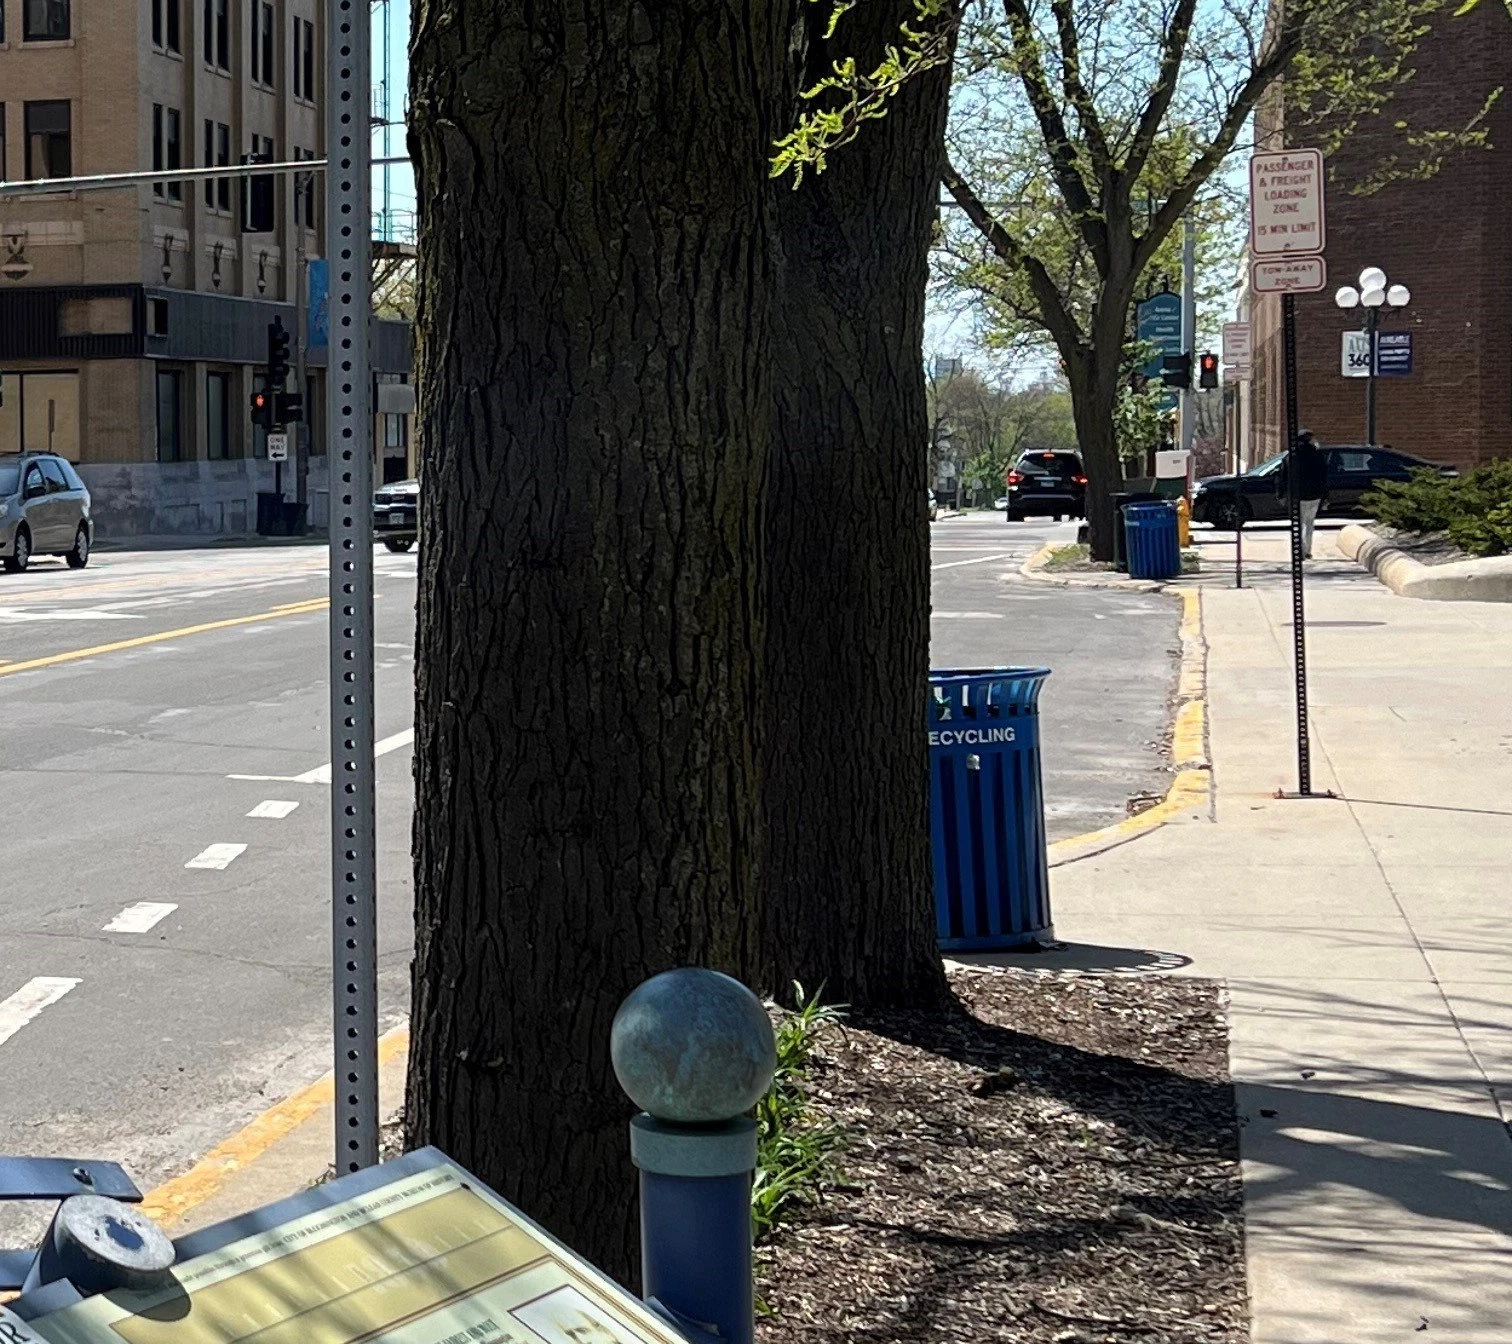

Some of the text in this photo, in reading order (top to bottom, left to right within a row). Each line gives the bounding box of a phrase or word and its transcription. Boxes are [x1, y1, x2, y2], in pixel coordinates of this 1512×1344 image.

[1256, 159, 1314, 174] PASSENGER
[1271, 174, 1312, 186] FREIGHT
[1265, 189, 1308, 201] LOADING
[1273, 203, 1299, 214] ZONE
[929, 727, 1015, 746] ECYCLING
